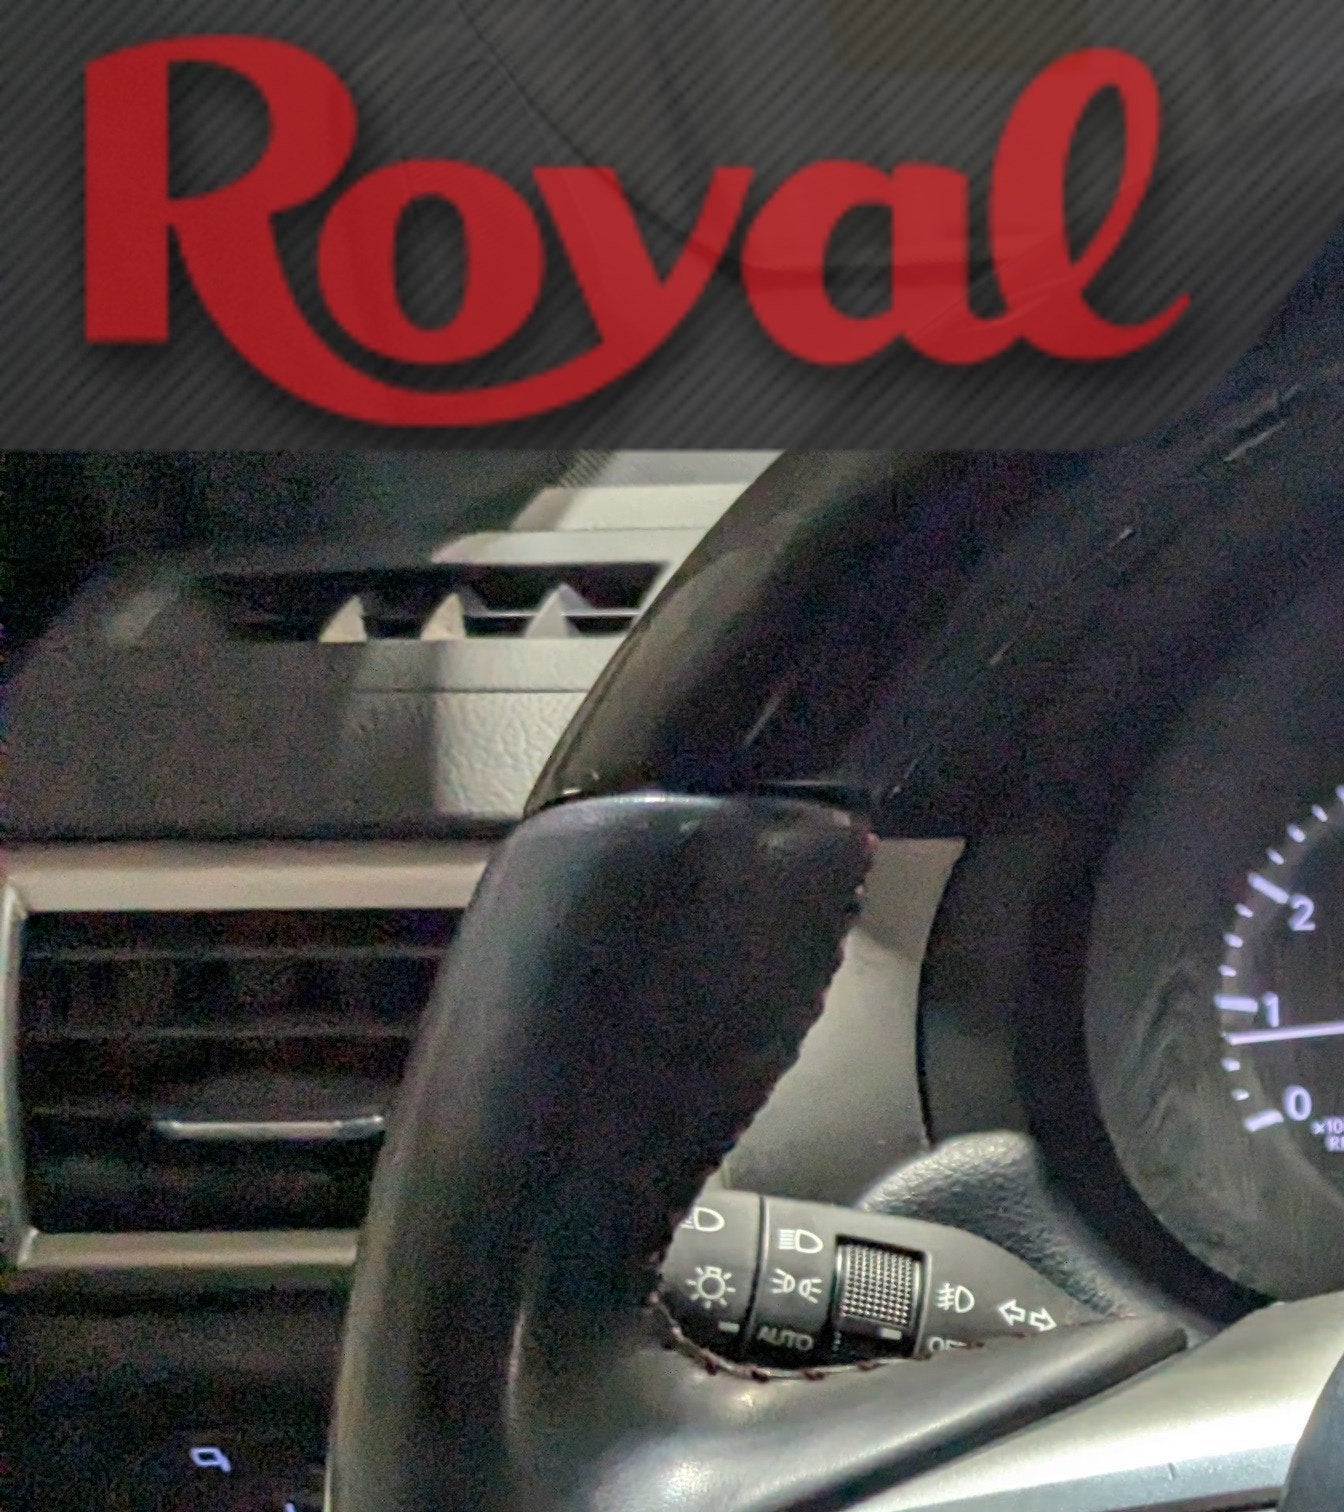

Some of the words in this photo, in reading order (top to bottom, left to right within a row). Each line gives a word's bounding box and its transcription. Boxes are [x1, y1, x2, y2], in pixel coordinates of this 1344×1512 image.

[1289, 894, 1316, 932] 2
[1262, 993, 1281, 1028] 1
[1283, 1085, 1313, 1119] 0
[756, 1325, 814, 1351] AUTO
